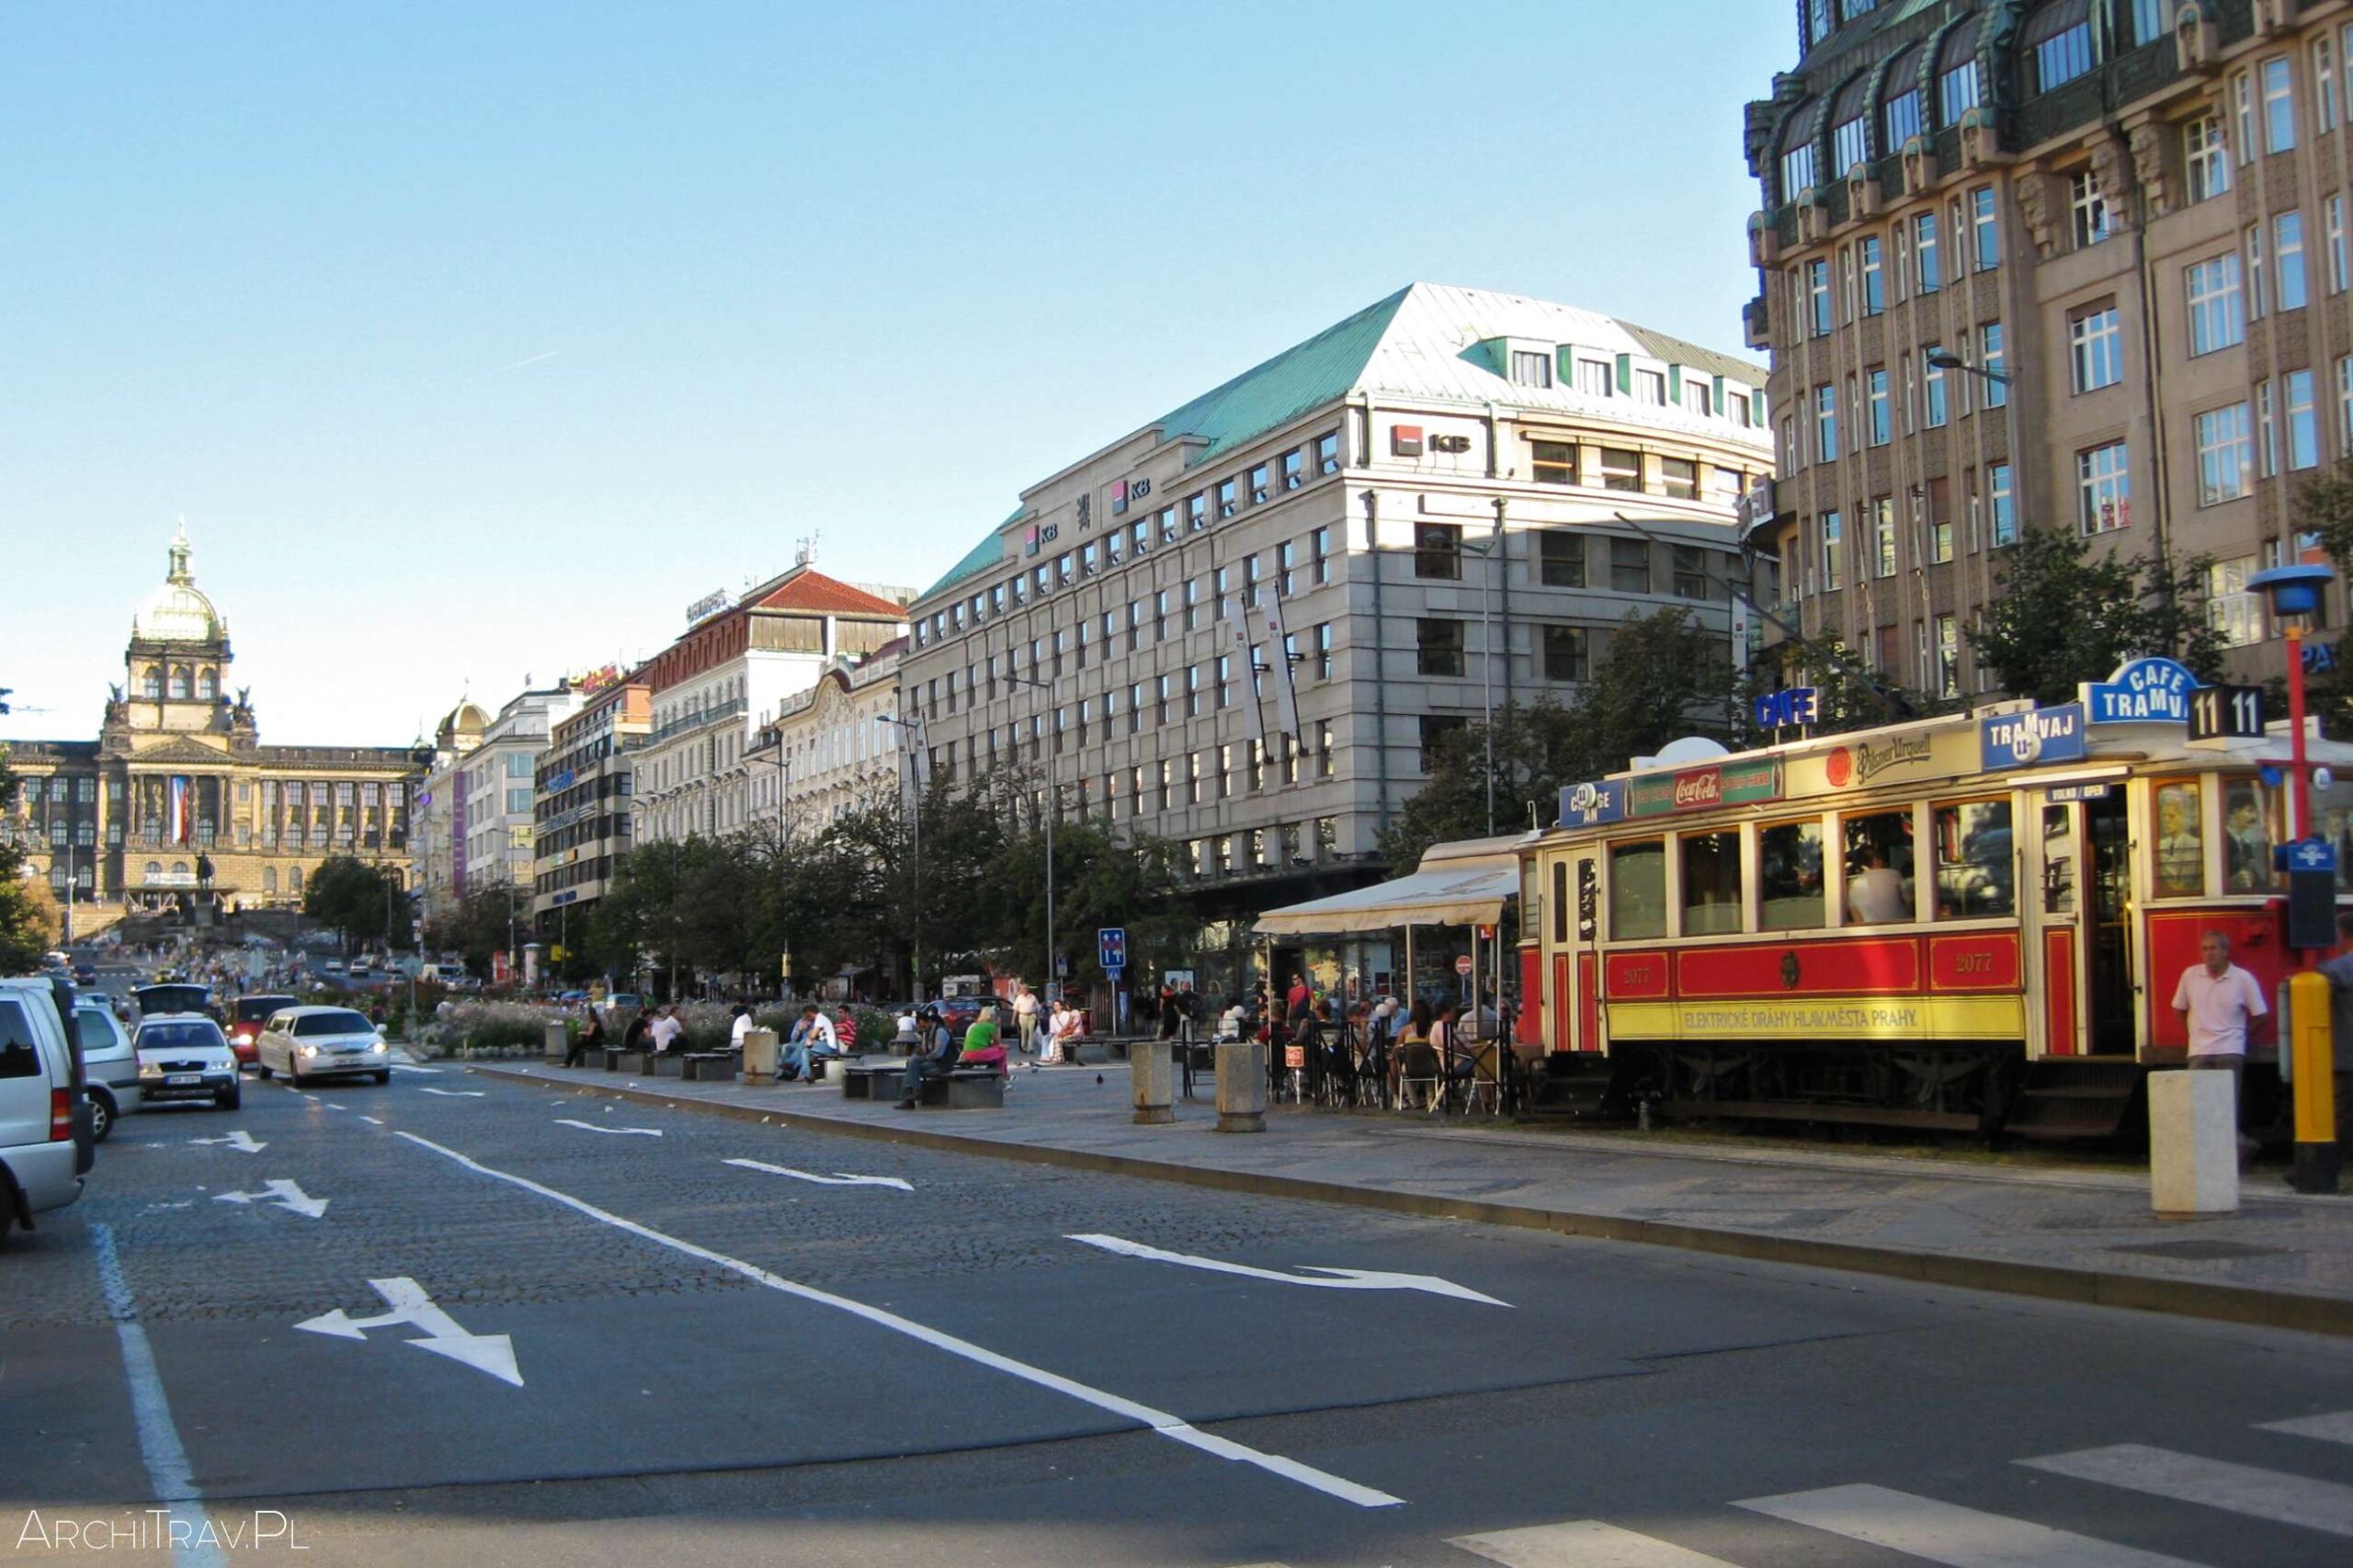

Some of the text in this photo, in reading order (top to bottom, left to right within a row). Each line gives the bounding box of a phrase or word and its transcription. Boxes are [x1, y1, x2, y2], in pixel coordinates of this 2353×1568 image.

[1428, 434, 1471, 453] KB
[1131, 478, 1151, 501] KB
[1040, 523, 1058, 544] KB
[2129, 665, 2185, 693] CAFE
[1756, 687, 1818, 732] CAFE
[2103, 688, 2188, 718] TRAMV
[2194, 692, 2217, 735] 11
[2232, 691, 2257, 733] 11
[1991, 713, 2074, 746] TRAMVAJ
[1857, 733, 1931, 784] Pilsner Urquell
[1955, 952, 1993, 973] 2077
